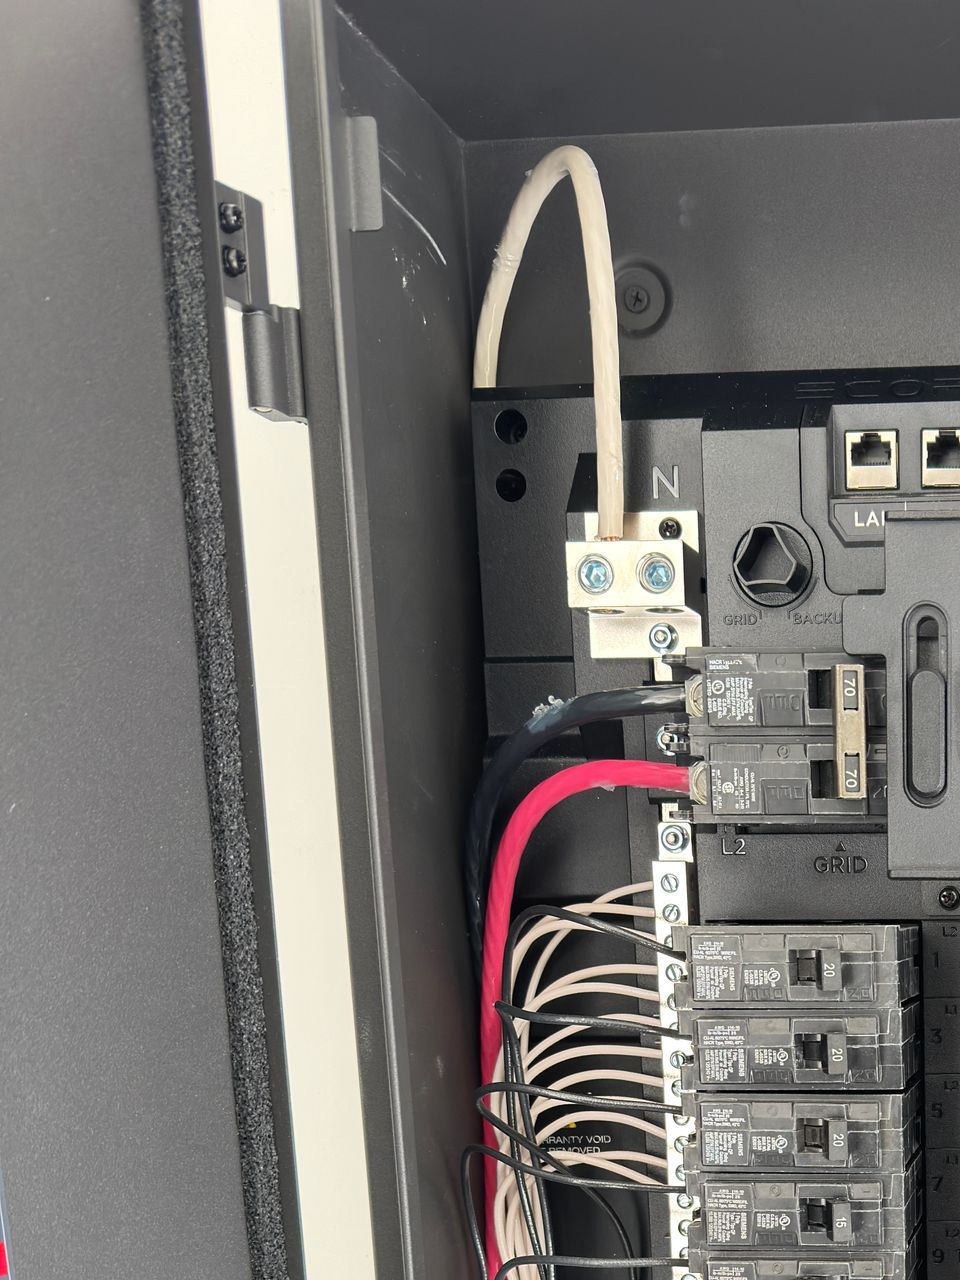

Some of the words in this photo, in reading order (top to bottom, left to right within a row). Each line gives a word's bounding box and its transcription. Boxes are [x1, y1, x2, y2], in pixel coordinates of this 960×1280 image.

[652, 465, 679, 499] N
[854, 511, 885, 526] LA
[724, 614, 757, 626] GRID
[793, 613, 843, 625] BACKU
[844, 678, 856, 697] 70
[845, 769, 858, 788] 70
[721, 838, 746, 855] L2
[814, 856, 868, 873] GRID
[942, 927, 958, 937] L2
[824, 963, 835, 977] 20
[832, 1048, 843, 1062] 20
[931, 1103, 942, 1118] 5
[543, 1135, 583, 1144] RANTY
[586, 1135, 612, 1144] VOID
[833, 1133, 844, 1147] 20
[931, 1177, 944, 1191] 7
[836, 1217, 847, 1228] 15
[932, 1248, 944, 1263] 9
